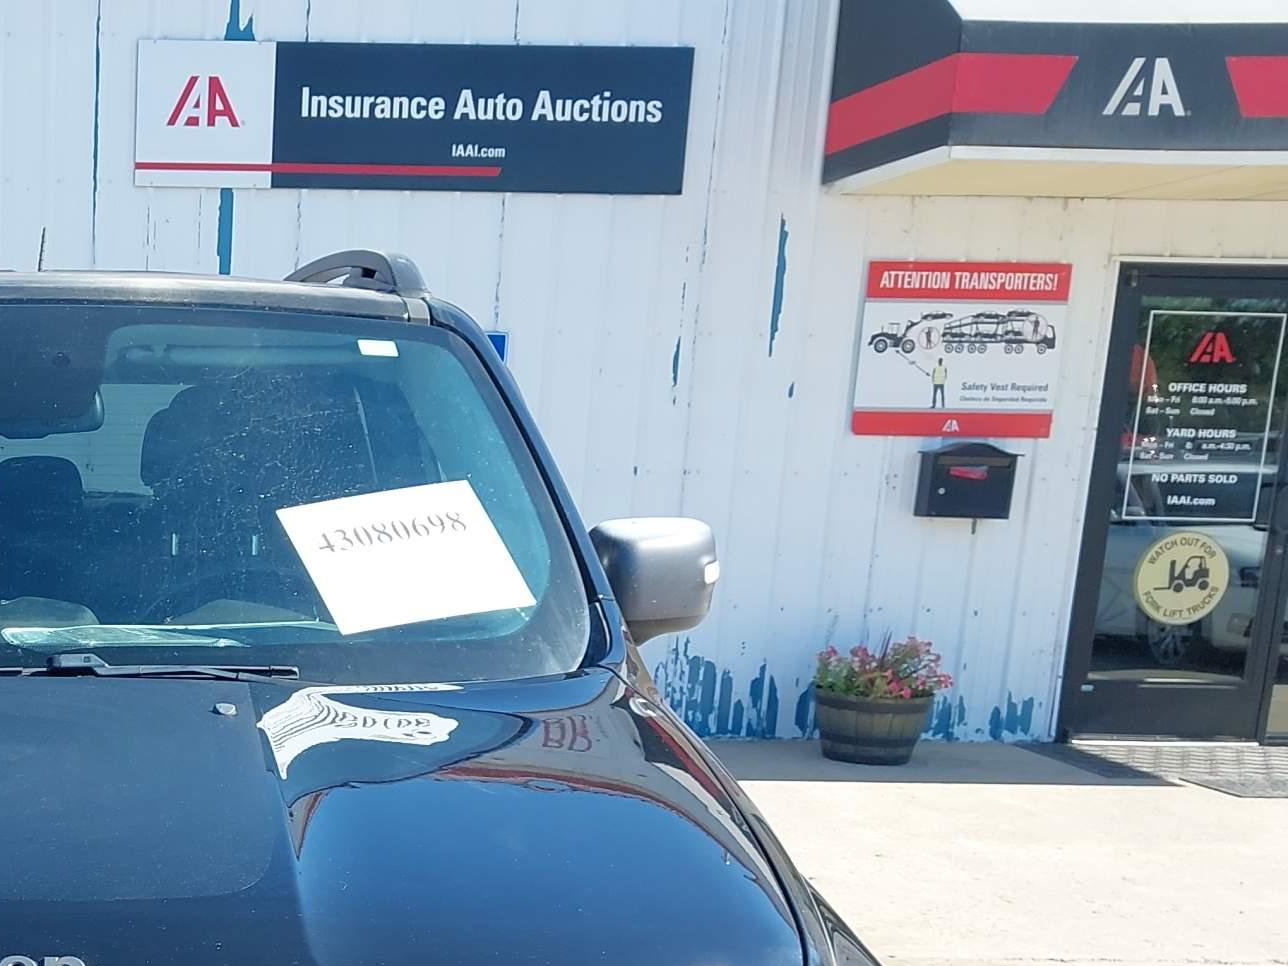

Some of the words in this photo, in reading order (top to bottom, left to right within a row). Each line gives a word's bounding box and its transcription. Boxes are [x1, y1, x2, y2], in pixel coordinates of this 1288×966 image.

[301, 86, 445, 120] Insurance
[453, 89, 523, 121] Auto
[531, 90, 663, 123] Auctions
[452, 144, 506, 158] IAAI.com
[879, 271, 951, 289] ATTENTION
[955, 272, 1059, 291] TRANSPORTERS!
[961, 382, 988, 392] Safety
[990, 383, 1009, 391] Vest
[1010, 383, 1049, 393] Required
[1168, 382, 1206, 393] OFFICE
[1208, 383, 1247, 393] HOURS
[1166, 428, 1196, 438] YARD
[1198, 428, 1236, 439] HOURS
[1151, 473, 1169, 483] NO
[1170, 473, 1206, 483] PARTS
[1208, 474, 1238, 484] SOLD
[1167, 495, 1215, 506] IAAI.com
[318, 512, 467, 553] 43080698
[1147, 539, 1178, 565] WATCH
[1180, 537, 1200, 547] OUT
[1200, 541, 1217, 559] FOR
[1163, 607, 1184, 618] LIFT
[1186, 585, 1220, 617] TRUCKS
